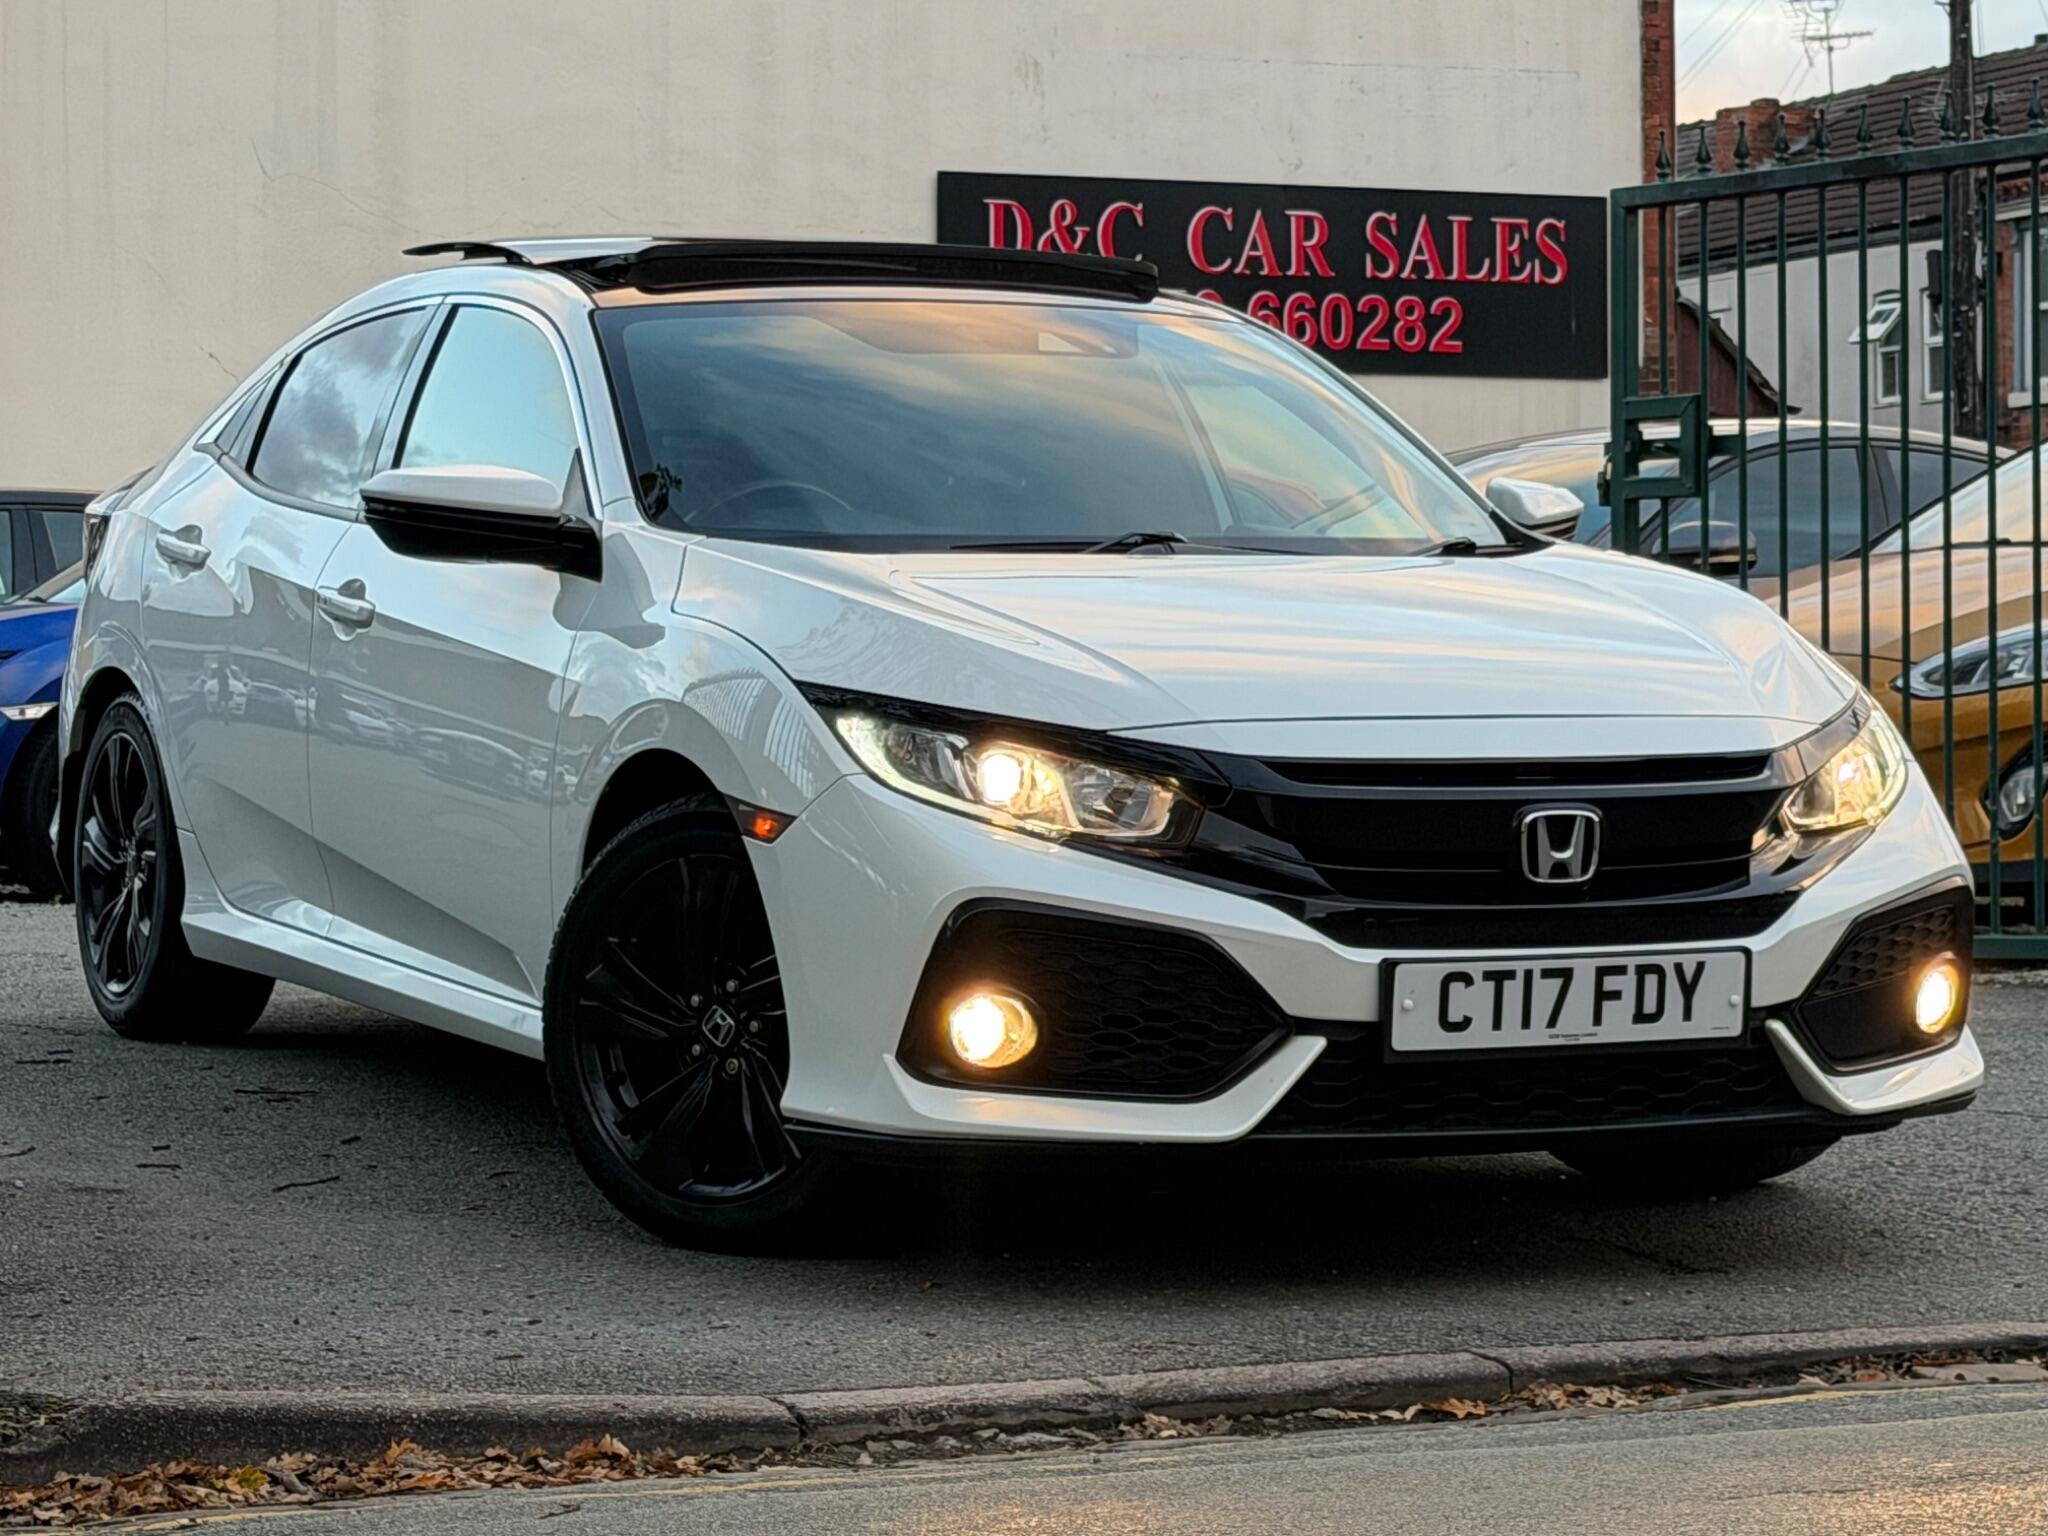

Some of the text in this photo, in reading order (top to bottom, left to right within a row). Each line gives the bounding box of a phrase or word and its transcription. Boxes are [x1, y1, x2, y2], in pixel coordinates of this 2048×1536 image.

[982, 198, 1568, 284] D&C CAR SALES
[1438, 960, 1706, 1033] CT17 FDY
